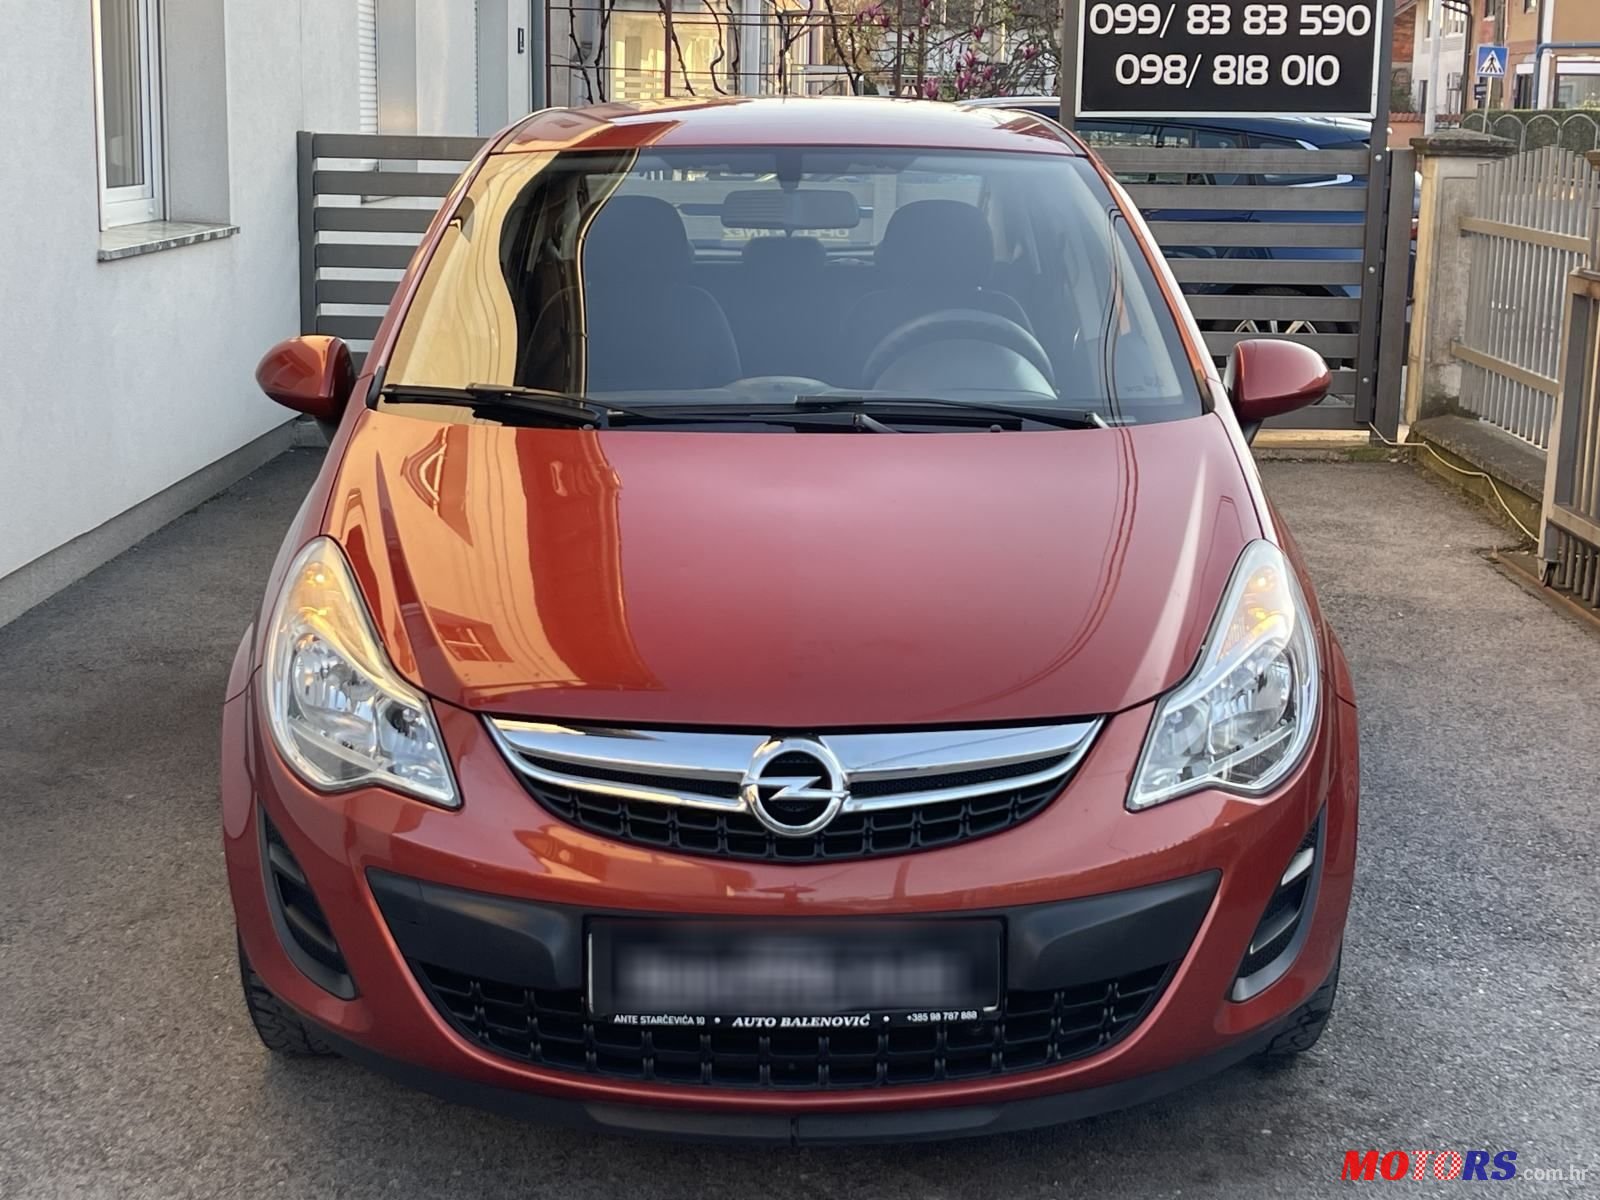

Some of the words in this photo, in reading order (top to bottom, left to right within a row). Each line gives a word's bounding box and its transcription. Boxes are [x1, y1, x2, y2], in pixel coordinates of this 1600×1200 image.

[1089, 3, 1176, 39] 099/
[1186, 3, 1231, 36] 83
[1242, 3, 1288, 36] 83
[1299, 4, 1372, 37] 590
[1115, 53, 1202, 89] 098/
[1212, 54, 1269, 86] 818
[1281, 54, 1340, 87] 010
[613, 1014, 639, 1025] ANTE
[732, 1016, 777, 1028] AUTO
[780, 1013, 871, 1028] BALENOVIĆ
